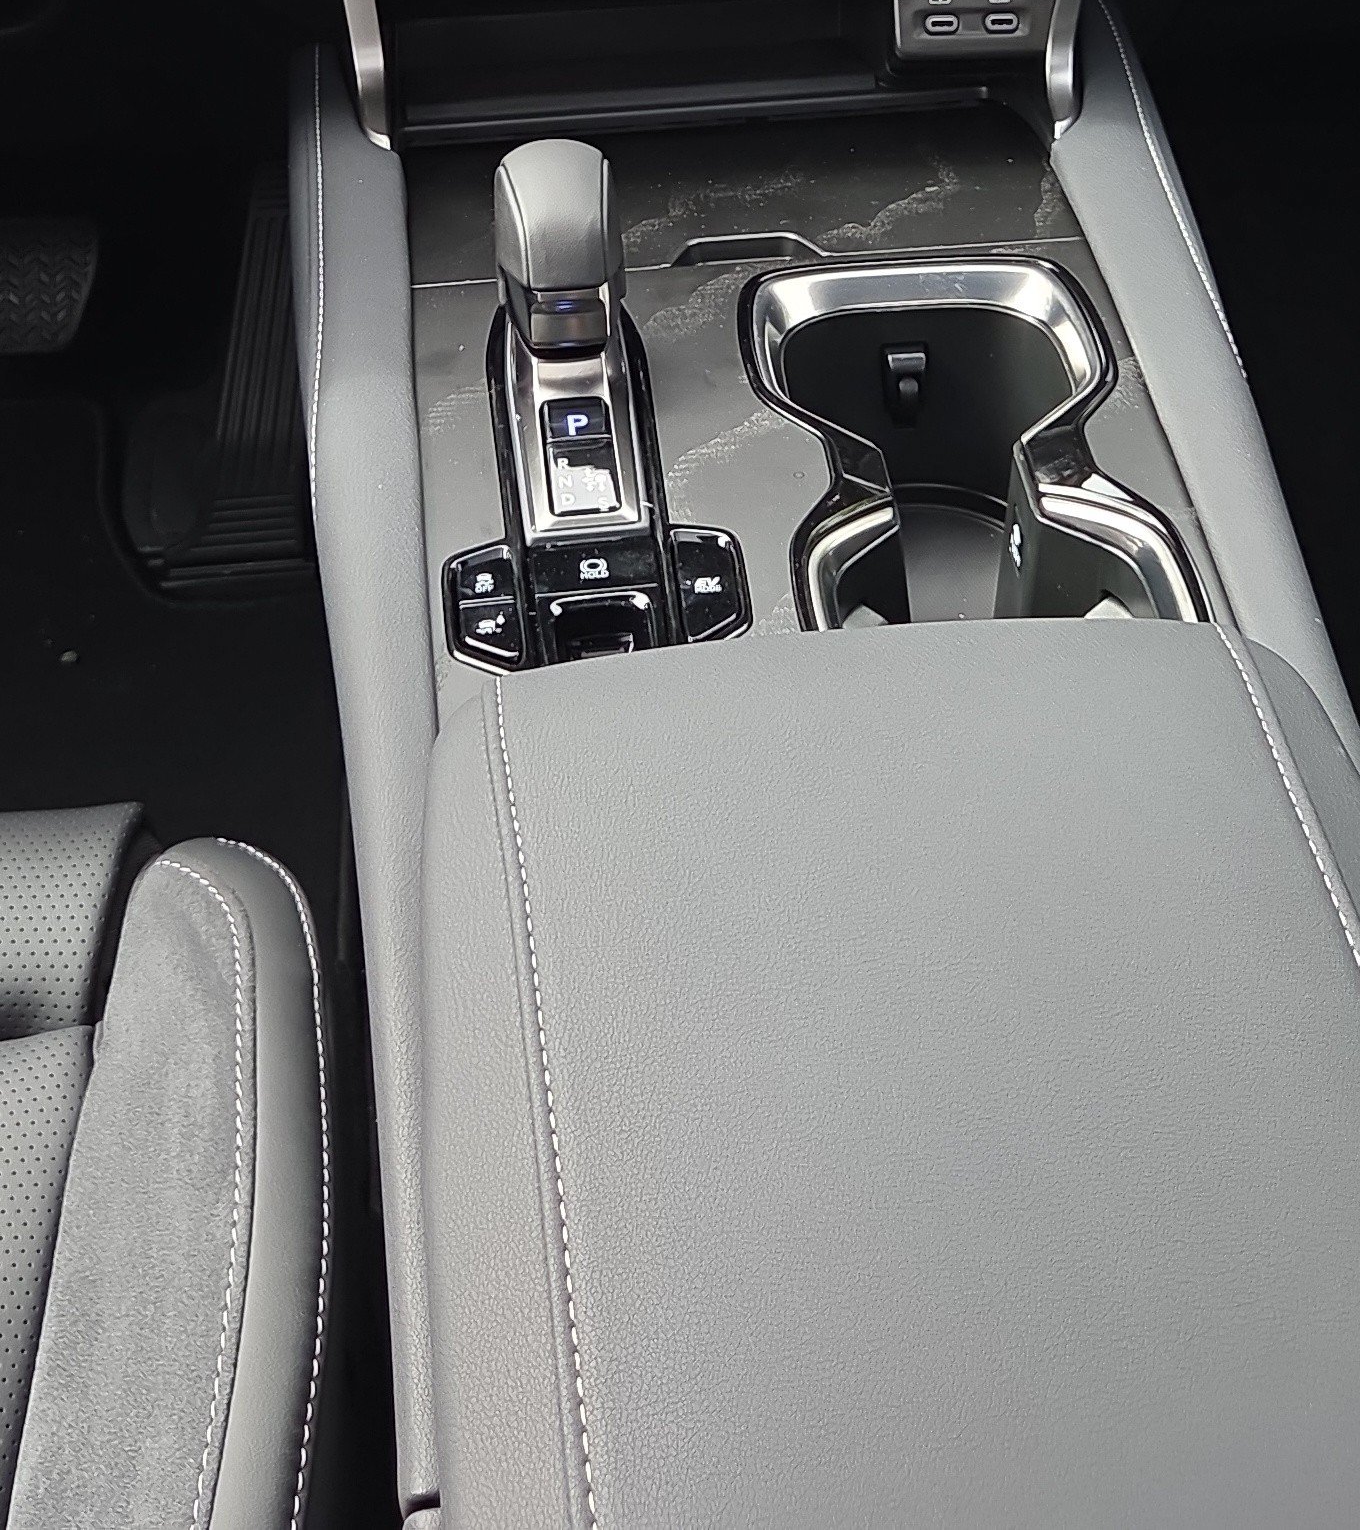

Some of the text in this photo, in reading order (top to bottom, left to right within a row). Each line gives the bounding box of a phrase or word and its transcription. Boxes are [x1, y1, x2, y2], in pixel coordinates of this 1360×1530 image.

[566, 414, 589, 436] P
[557, 457, 569, 470] R
[558, 475, 573, 489] N
[561, 493, 610, 510] D S
[580, 570, 609, 580] HOLD
[475, 583, 494, 594] OFF
